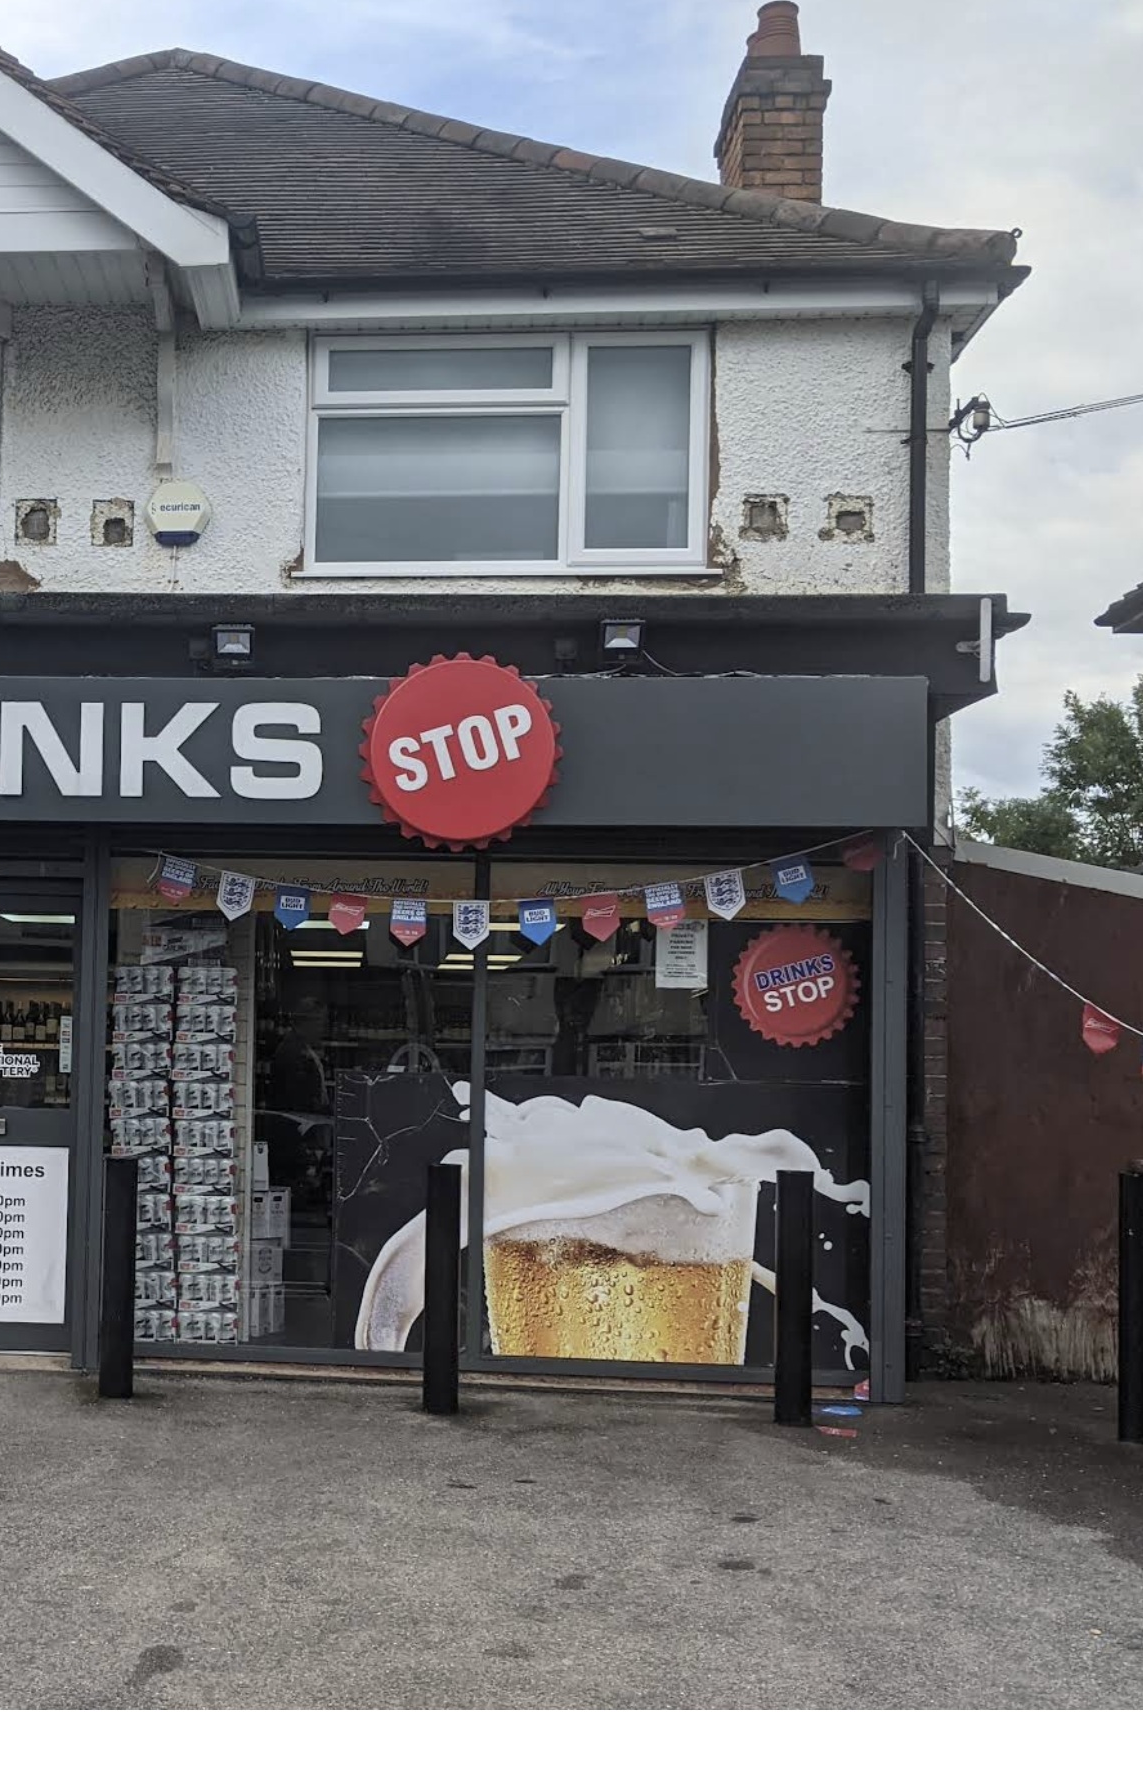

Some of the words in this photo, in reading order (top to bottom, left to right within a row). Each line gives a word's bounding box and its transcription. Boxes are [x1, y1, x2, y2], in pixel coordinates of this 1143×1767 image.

[388, 703, 534, 793] STOP
[755, 954, 834, 990] DRINKS
[764, 977, 834, 1011] STOP
